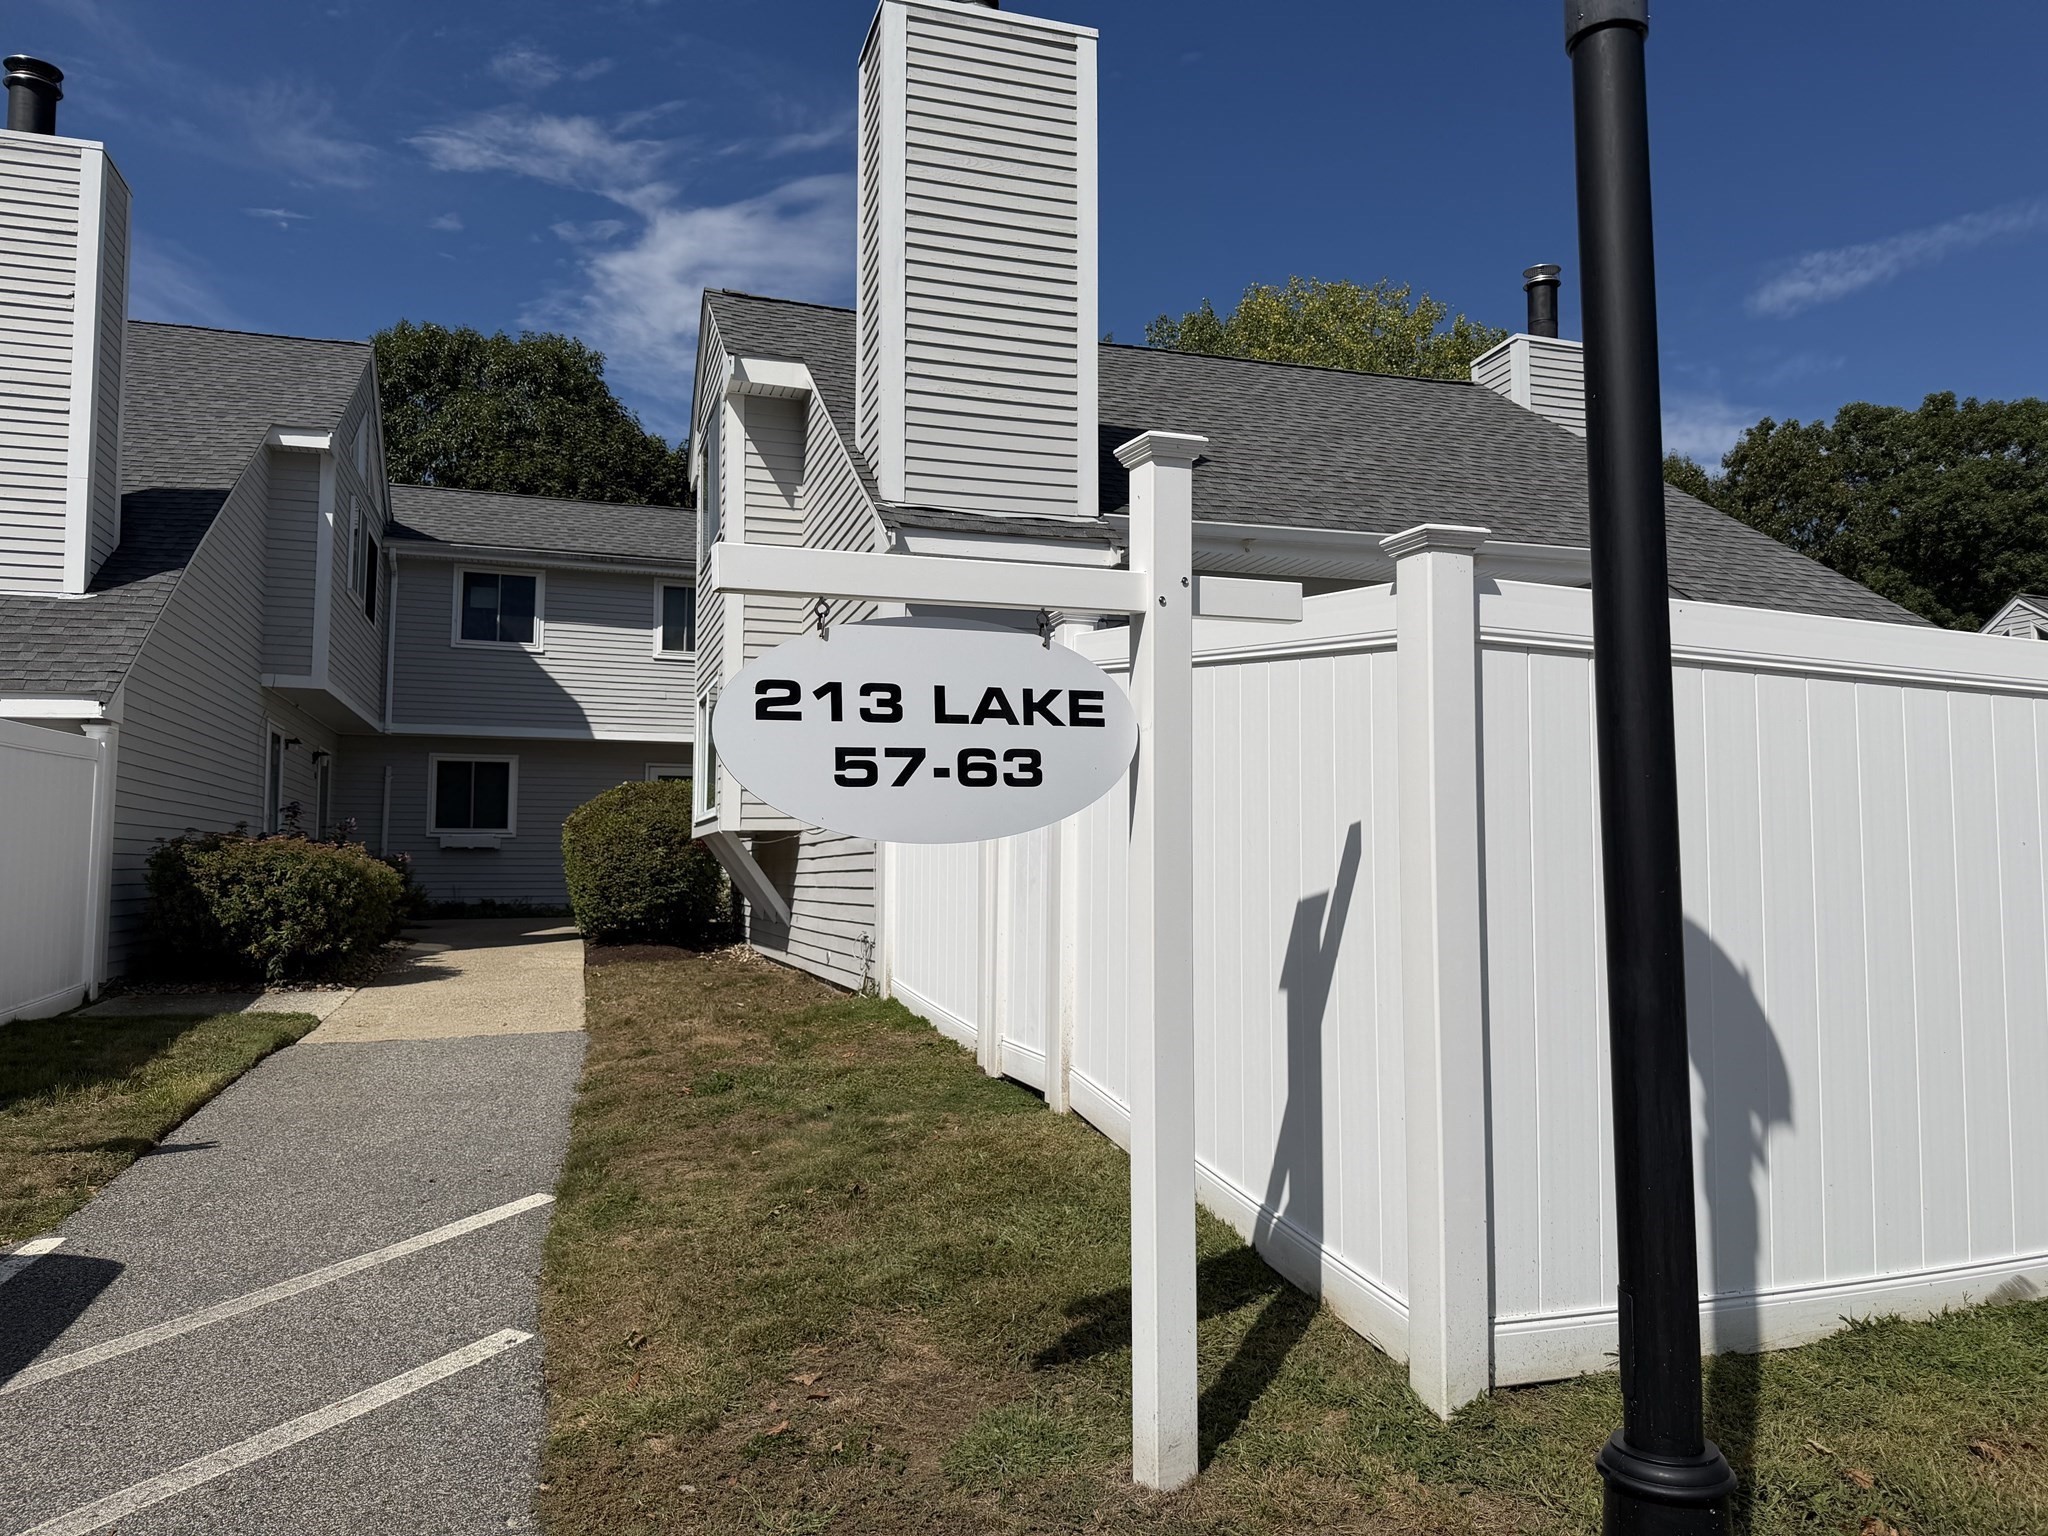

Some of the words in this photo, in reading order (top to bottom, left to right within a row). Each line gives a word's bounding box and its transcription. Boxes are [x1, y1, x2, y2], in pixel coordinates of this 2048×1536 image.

[754, 679, 904, 724] 213
[933, 684, 1106, 728] LAKE
[833, 746, 1043, 788] 57-63
